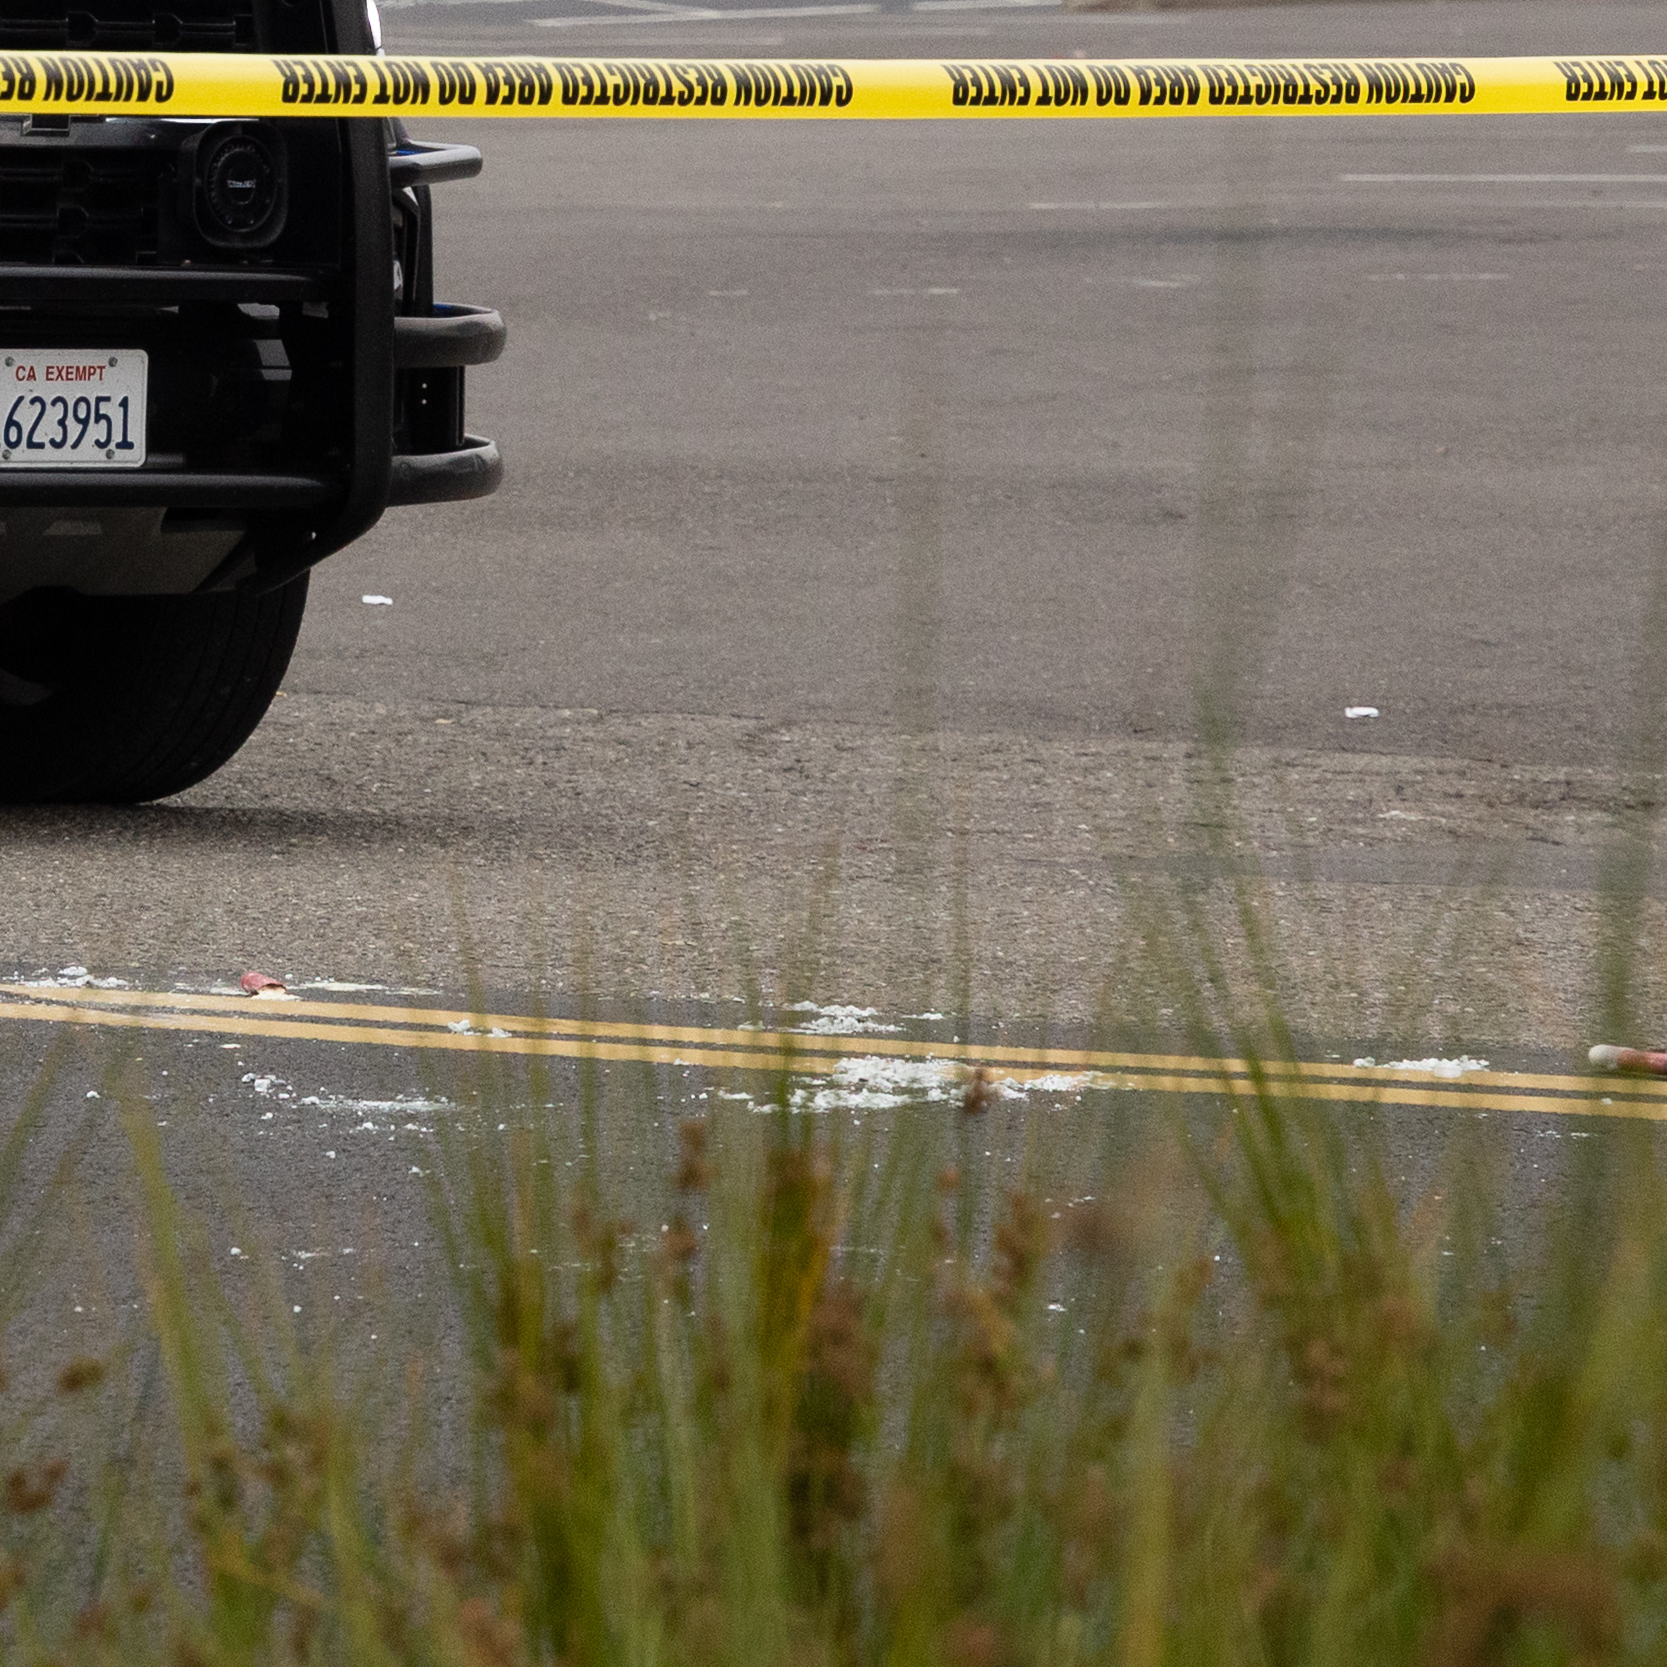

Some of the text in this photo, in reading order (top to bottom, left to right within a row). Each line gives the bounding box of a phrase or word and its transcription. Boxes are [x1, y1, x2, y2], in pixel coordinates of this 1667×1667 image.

[36, 55, 175, 103] CAUTION
[270, 58, 854, 108] CAUTION RESTRICTED AREA DO NOT ENTER
[939, 61, 1477, 107] CAUTION RESTRICTED AREA DO NOT ENTER
[1552, 59, 1638, 102] ENTER
[15, 365, 106, 381] CA EXEMPT
